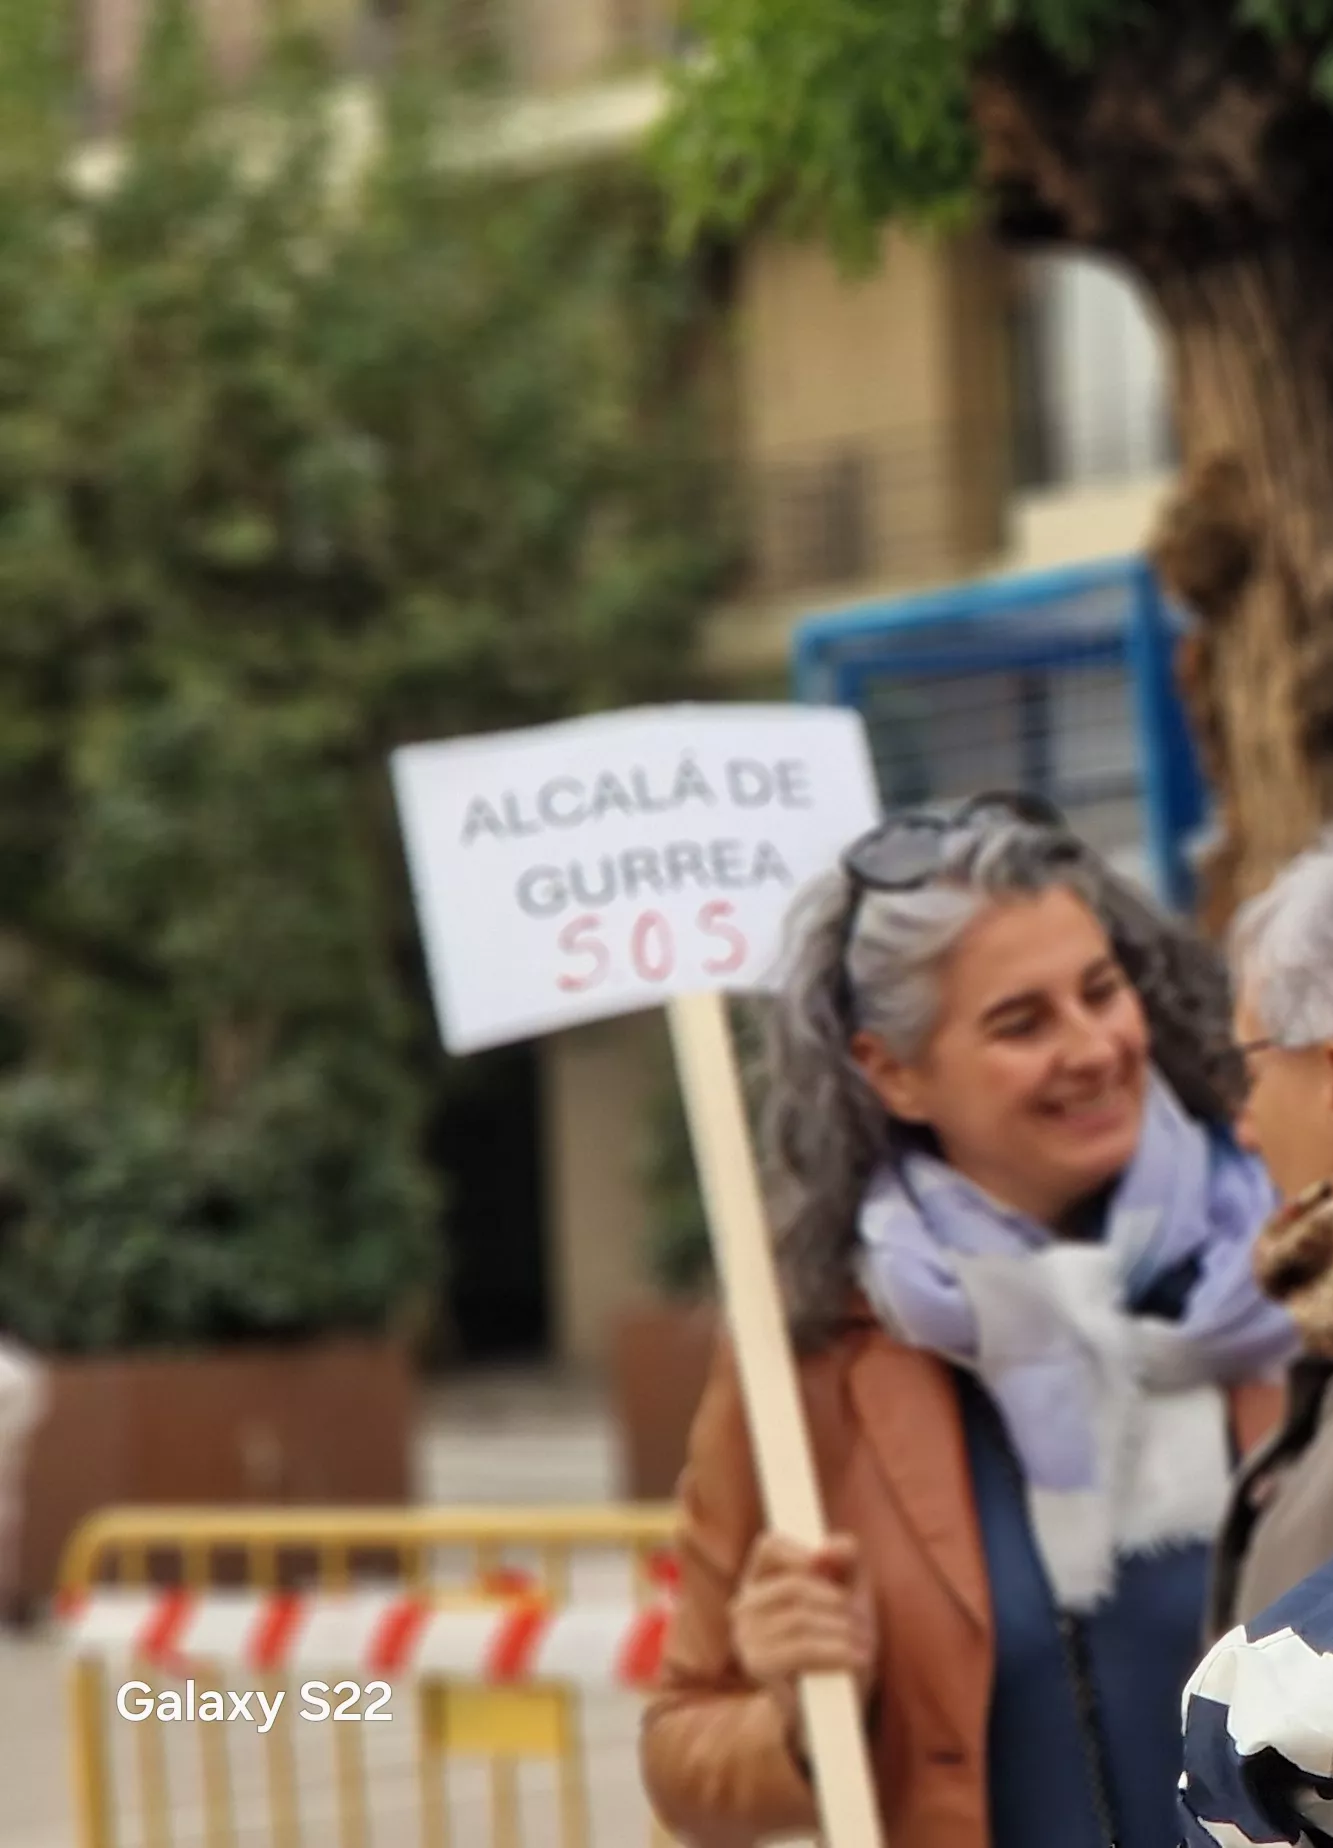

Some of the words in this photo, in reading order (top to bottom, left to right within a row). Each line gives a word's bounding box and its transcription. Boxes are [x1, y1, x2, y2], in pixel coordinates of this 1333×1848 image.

[459, 749, 718, 846] ALCALÁ
[724, 757, 814, 809] DE
[515, 838, 795, 918] GURREA
[557, 899, 749, 992] SOS
